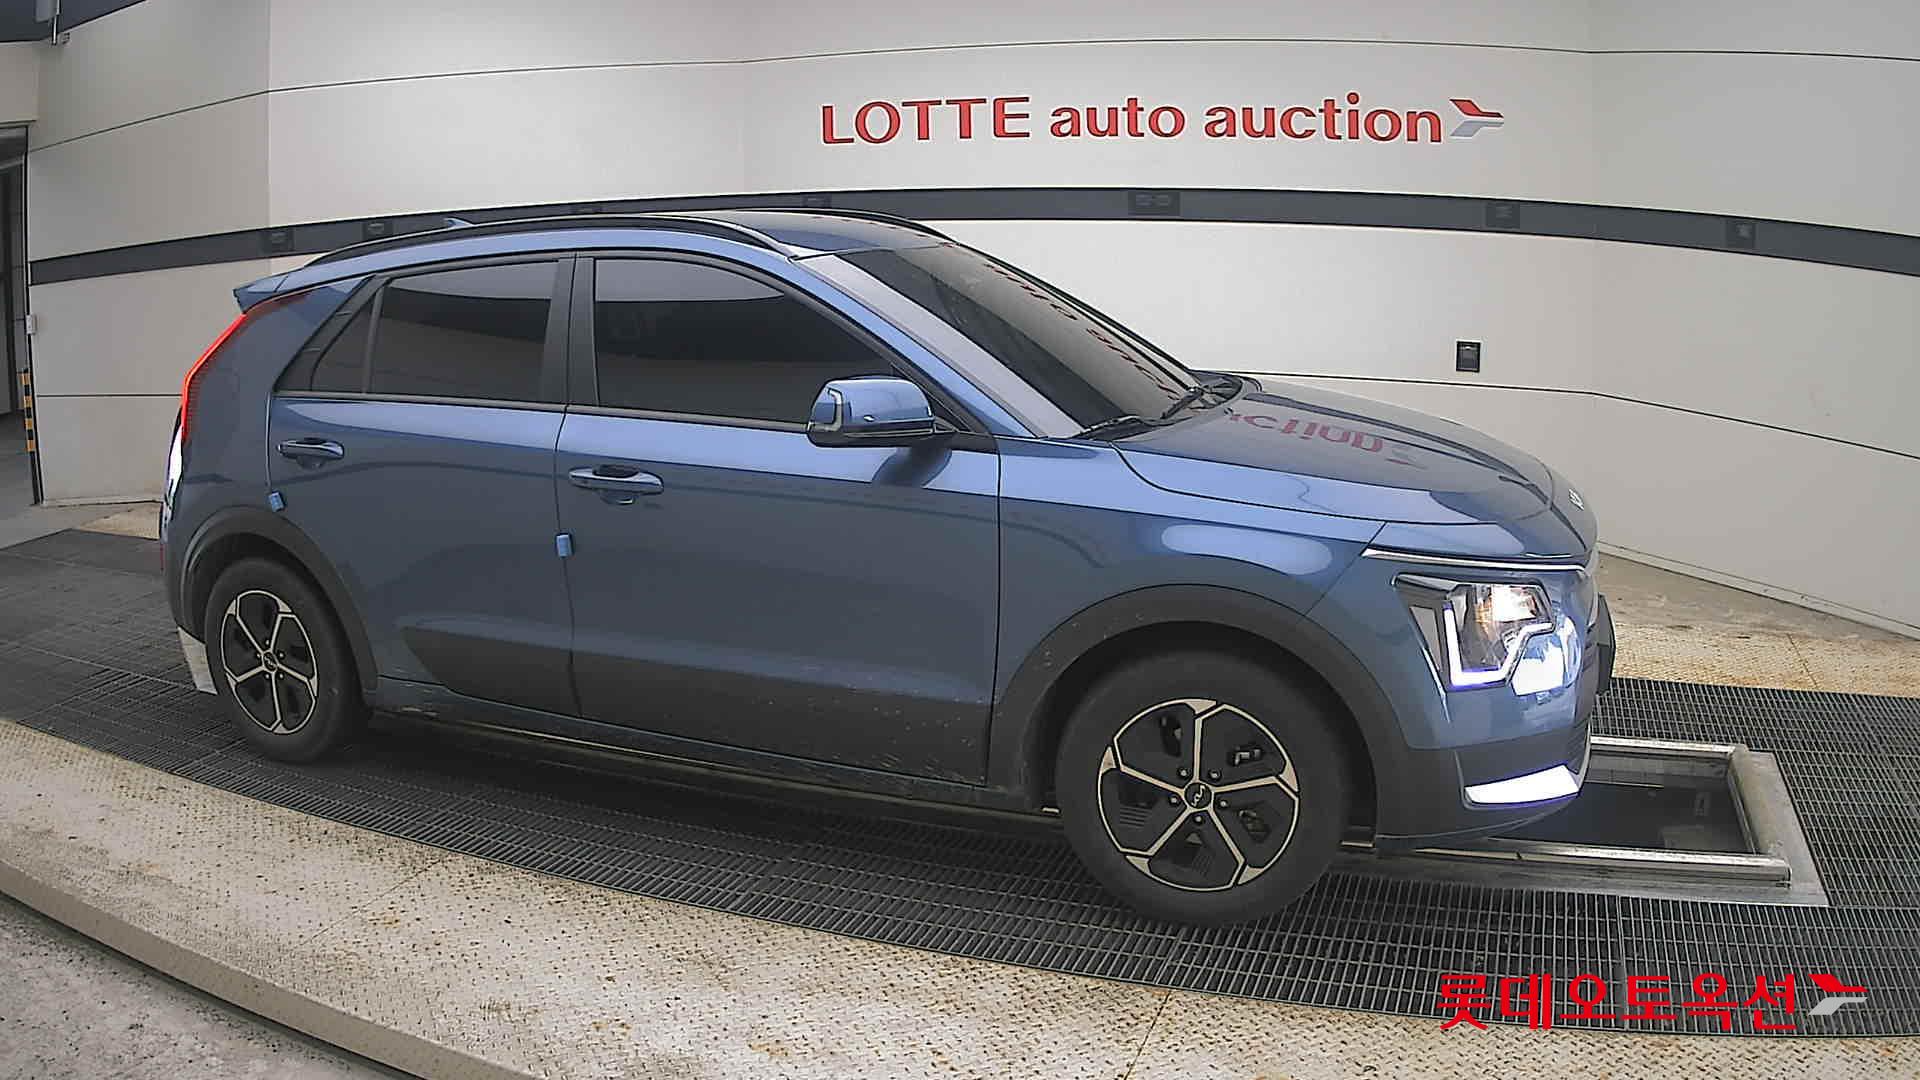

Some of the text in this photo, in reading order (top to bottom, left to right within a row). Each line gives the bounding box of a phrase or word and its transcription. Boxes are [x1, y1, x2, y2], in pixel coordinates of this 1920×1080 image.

[822, 92, 1443, 144] LOTTE auto auction
